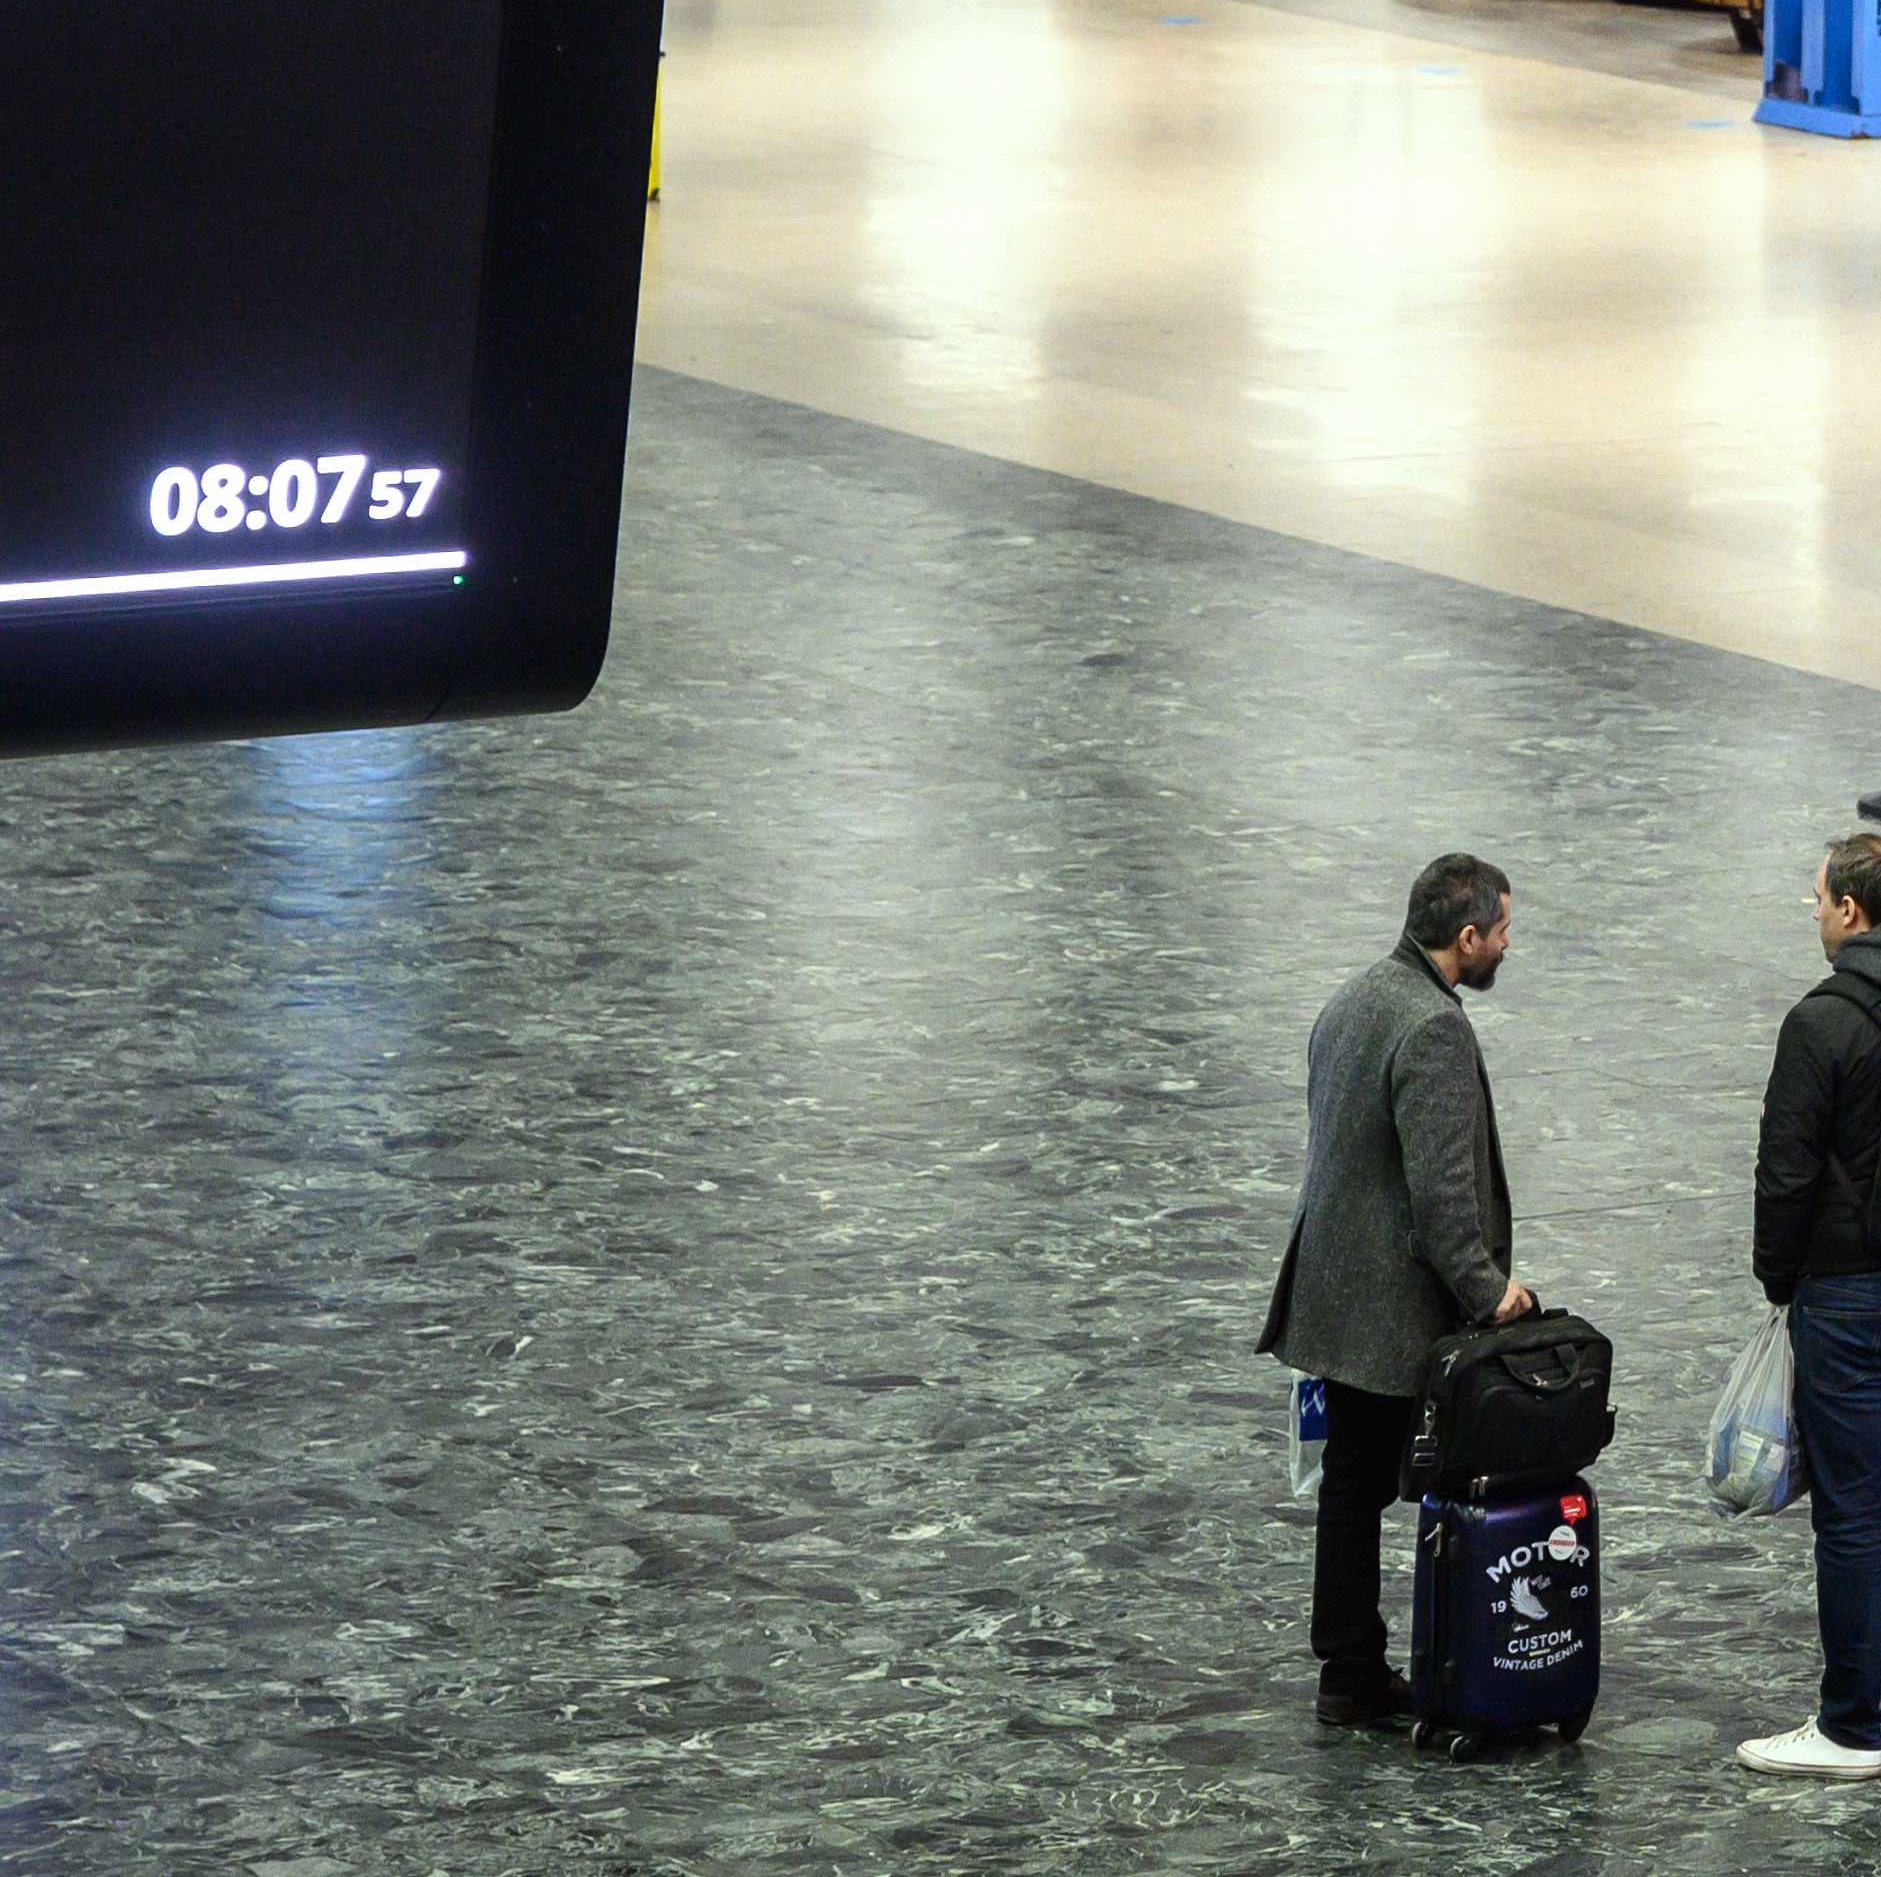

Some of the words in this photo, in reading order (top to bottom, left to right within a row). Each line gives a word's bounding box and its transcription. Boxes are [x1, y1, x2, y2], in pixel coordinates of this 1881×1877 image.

[149, 453, 367, 537] 08:07
[368, 467, 441, 521] 57
[1486, 1540, 1590, 1583] MOTR
[1490, 1600, 1507, 1614] 19
[1570, 1584, 1589, 1599] 60
[1492, 1656, 1544, 1671] VINTAGE
[1546, 1639, 1584, 1667] DENIM
[1507, 1628, 1572, 1654] CUSTOM
